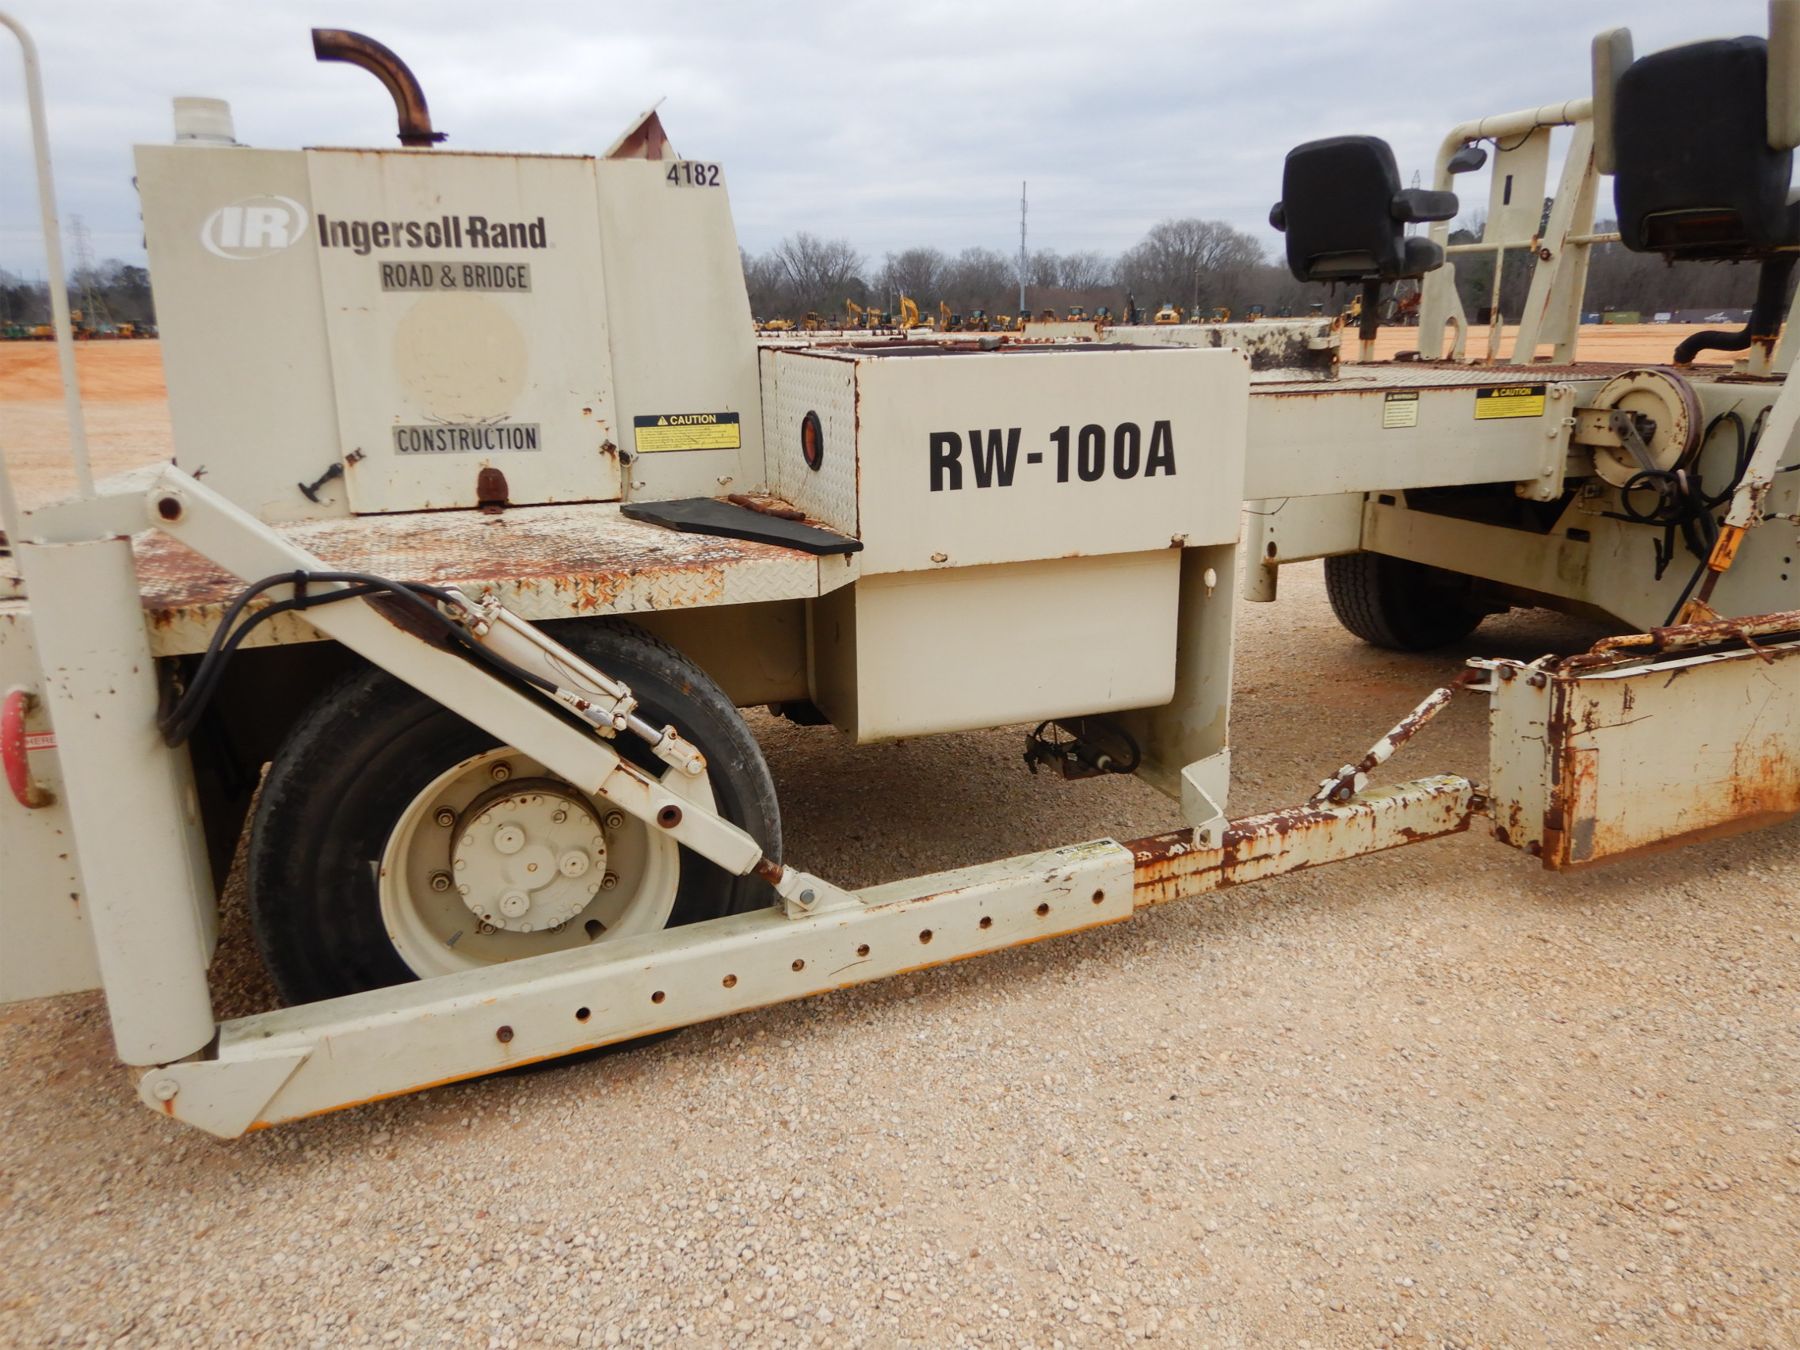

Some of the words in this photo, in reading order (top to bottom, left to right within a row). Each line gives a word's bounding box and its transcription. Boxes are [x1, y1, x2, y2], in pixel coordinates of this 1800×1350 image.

[666, 161, 720, 187] 4182
[220, 206, 289, 249] IR
[383, 263, 433, 288] ROAD
[440, 264, 457, 289] &
[463, 264, 528, 289] BRIDGE
[1500, 387, 1532, 396] CAUTION
[670, 414, 717, 425] CAUTION
[397, 427, 537, 452] CONSTRUCTION
[929, 420, 1177, 492] RW-100A
